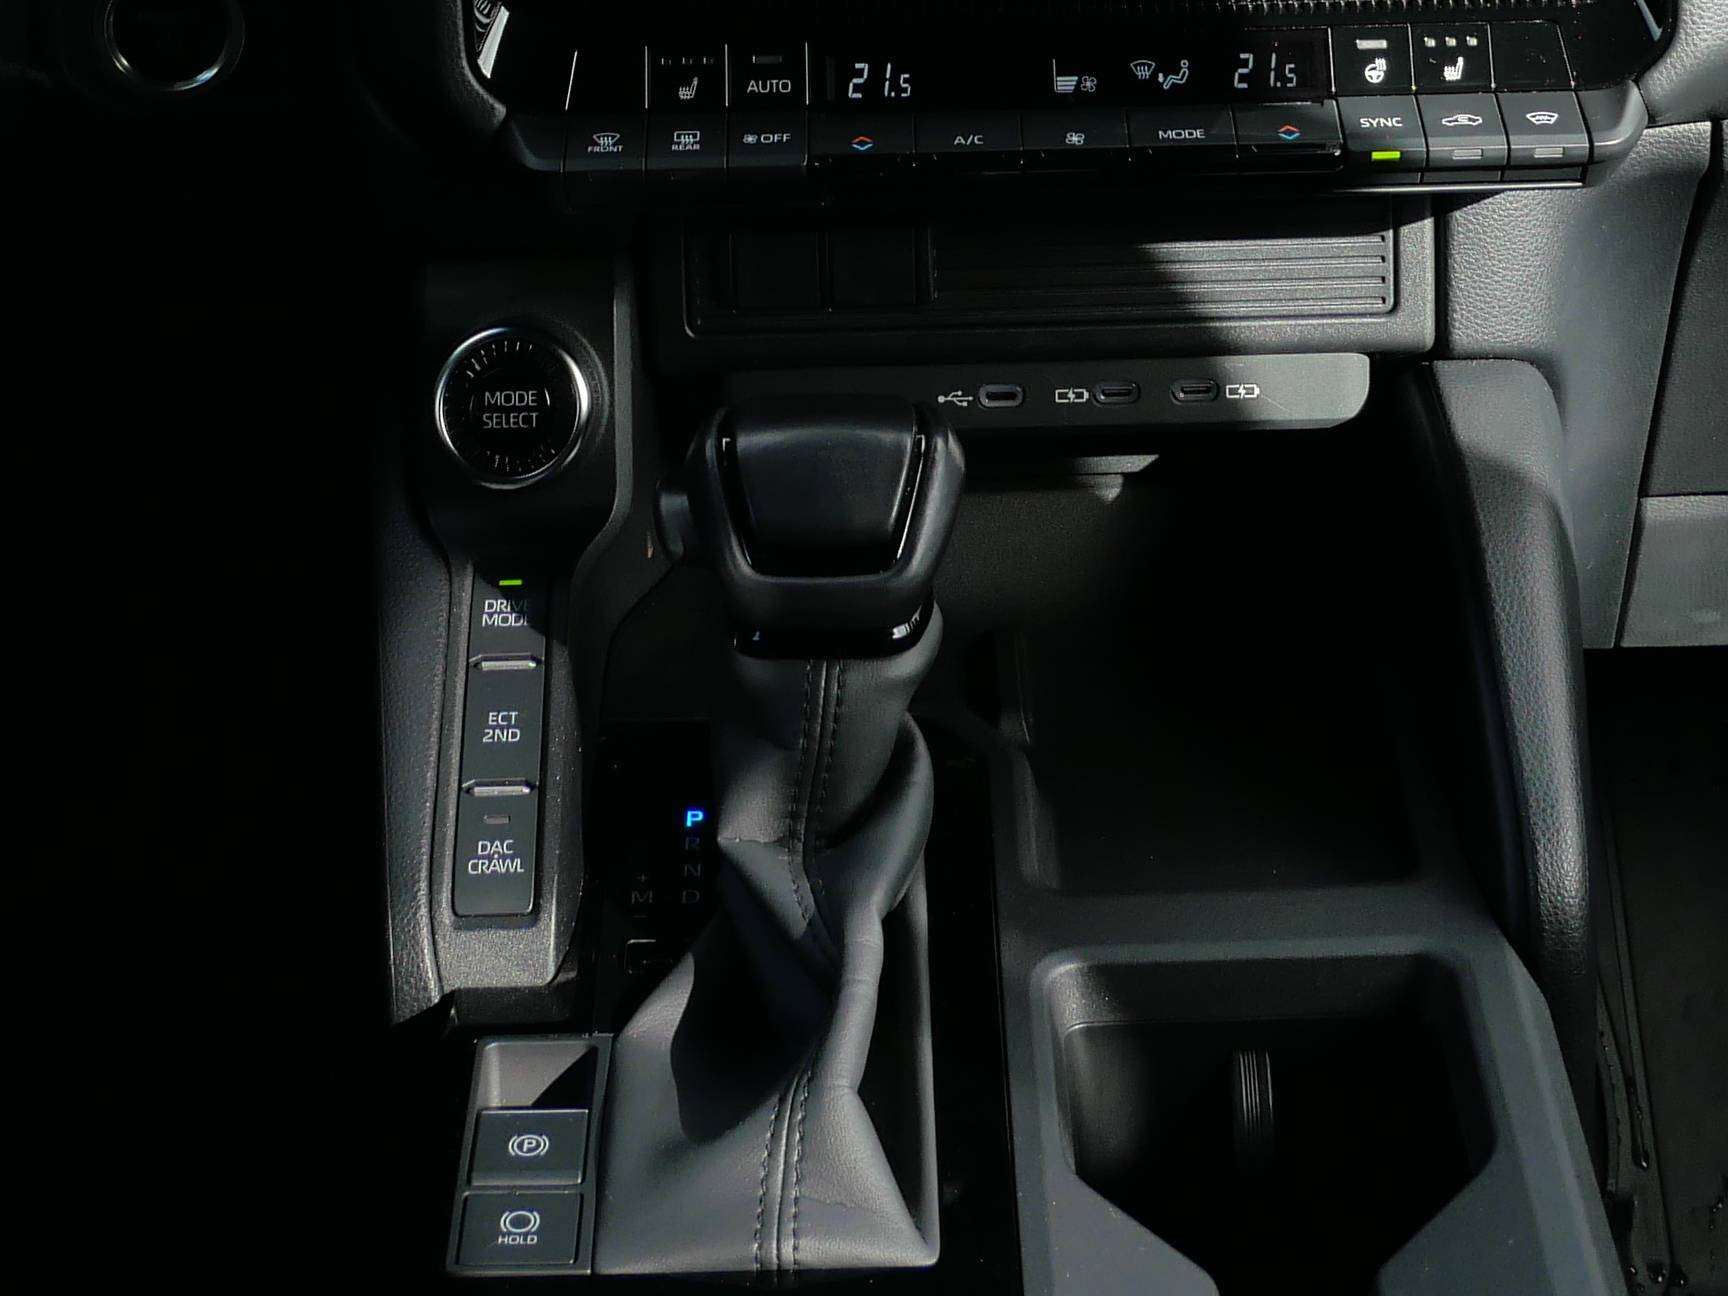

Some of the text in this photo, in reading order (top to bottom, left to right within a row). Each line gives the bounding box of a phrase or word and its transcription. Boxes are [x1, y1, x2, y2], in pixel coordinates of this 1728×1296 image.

[1233, 52, 1297, 89] 21.5
[746, 79, 792, 94] AUTO
[848, 63, 912, 99] 21.5
[1359, 114, 1404, 129] SYNC
[761, 132, 792, 145] OFF
[954, 133, 985, 147] A/C
[1158, 127, 1205, 141] MODE
[586, 144, 624, 154] FRONT
[669, 143, 699, 152] REAR
[484, 390, 538, 408] MODE
[482, 411, 539, 431] SELECT
[488, 711, 520, 727] ECT
[482, 727, 521, 744] 2ND
[685, 810, 704, 828] P
[478, 840, 515, 856] DAC
[684, 836, 702, 852] R
[467, 857, 525, 875] CRAWL
[682, 863, 702, 879] N
[630, 889, 700, 905] M D
[497, 1234, 539, 1246] HOLD
